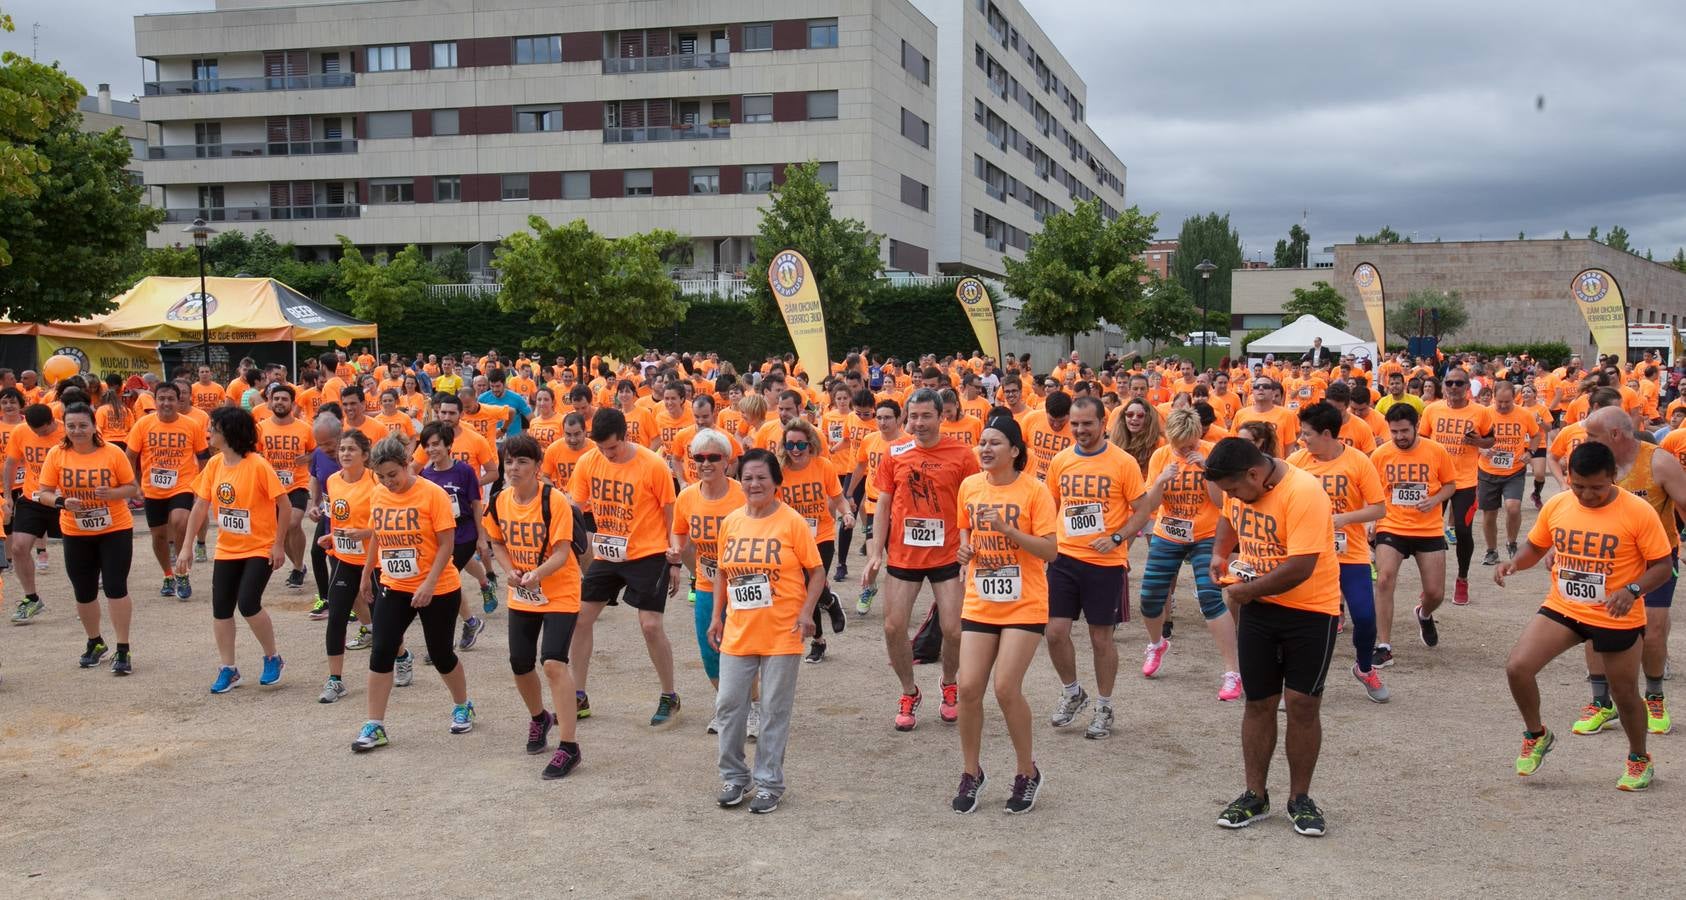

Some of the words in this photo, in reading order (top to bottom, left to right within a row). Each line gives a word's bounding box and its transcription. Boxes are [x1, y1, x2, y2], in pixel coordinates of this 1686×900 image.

[231, 331, 257, 341] CORRER
[100, 356, 128, 369] MUCHO
[197, 393, 218, 403] BEER
[1436, 418, 1474, 434] BEER
[148, 432, 187, 448] BEER
[265, 436, 300, 450] BEER
[1034, 431, 1071, 451] BEER
[1494, 457, 1510, 466] 0375
[63, 468, 112, 488] BEER
[154, 475, 172, 485] 0337
[1386, 464, 1430, 483] BEER
[591, 477, 634, 506] BEER
[781, 482, 824, 505] BEER
[1060, 474, 1112, 498] BEER
[1398, 490, 1421, 501] 0353
[373, 507, 421, 531] BEER
[593, 503, 634, 521] RUNNERS
[82, 517, 106, 528] 0072
[223, 516, 244, 529] 0150
[1071, 514, 1097, 530] 0800
[1232, 505, 1281, 544] BEER
[911, 528, 936, 541] 0221
[723, 537, 782, 565] BEER
[1554, 527, 1620, 559] BEER
[598, 544, 620, 559] 0151
[387, 559, 412, 573] 0239
[735, 585, 762, 603] 0365
[983, 578, 1012, 594] 0133
[1566, 581, 1596, 599] 0530
